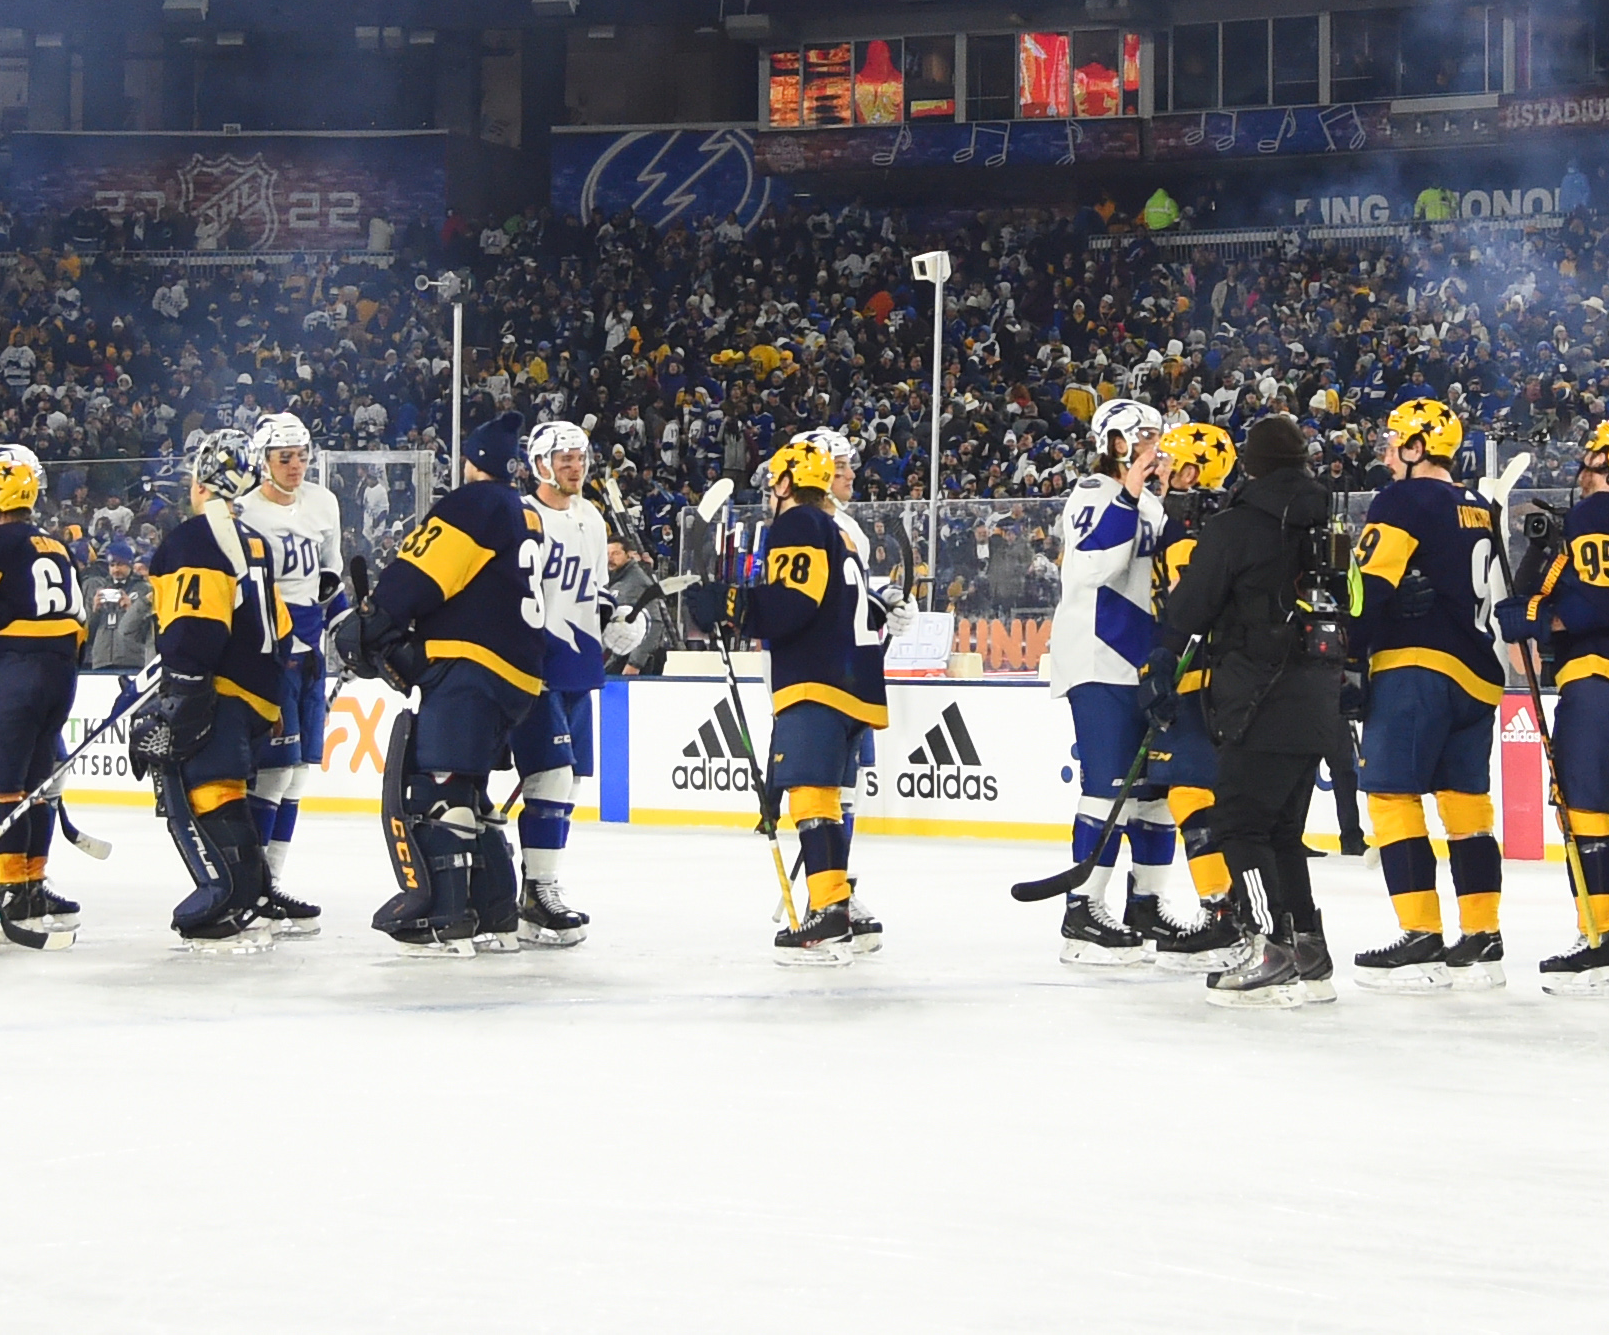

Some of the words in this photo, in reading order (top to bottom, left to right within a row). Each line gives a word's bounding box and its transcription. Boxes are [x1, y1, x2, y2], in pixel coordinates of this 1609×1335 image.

[289, 191, 363, 229] 22
[401, 525, 443, 559] 33
[1355, 527, 1382, 567] 9
[775, 552, 812, 585] 28
[174, 572, 203, 612] 14
[169, 672, 205, 682] TRUE
[1501, 726, 1541, 743] adidas
[672, 758, 764, 792] adidas
[896, 764, 999, 802] adidas
[187, 820, 220, 880] TRUE
[390, 815, 419, 890] CCM
